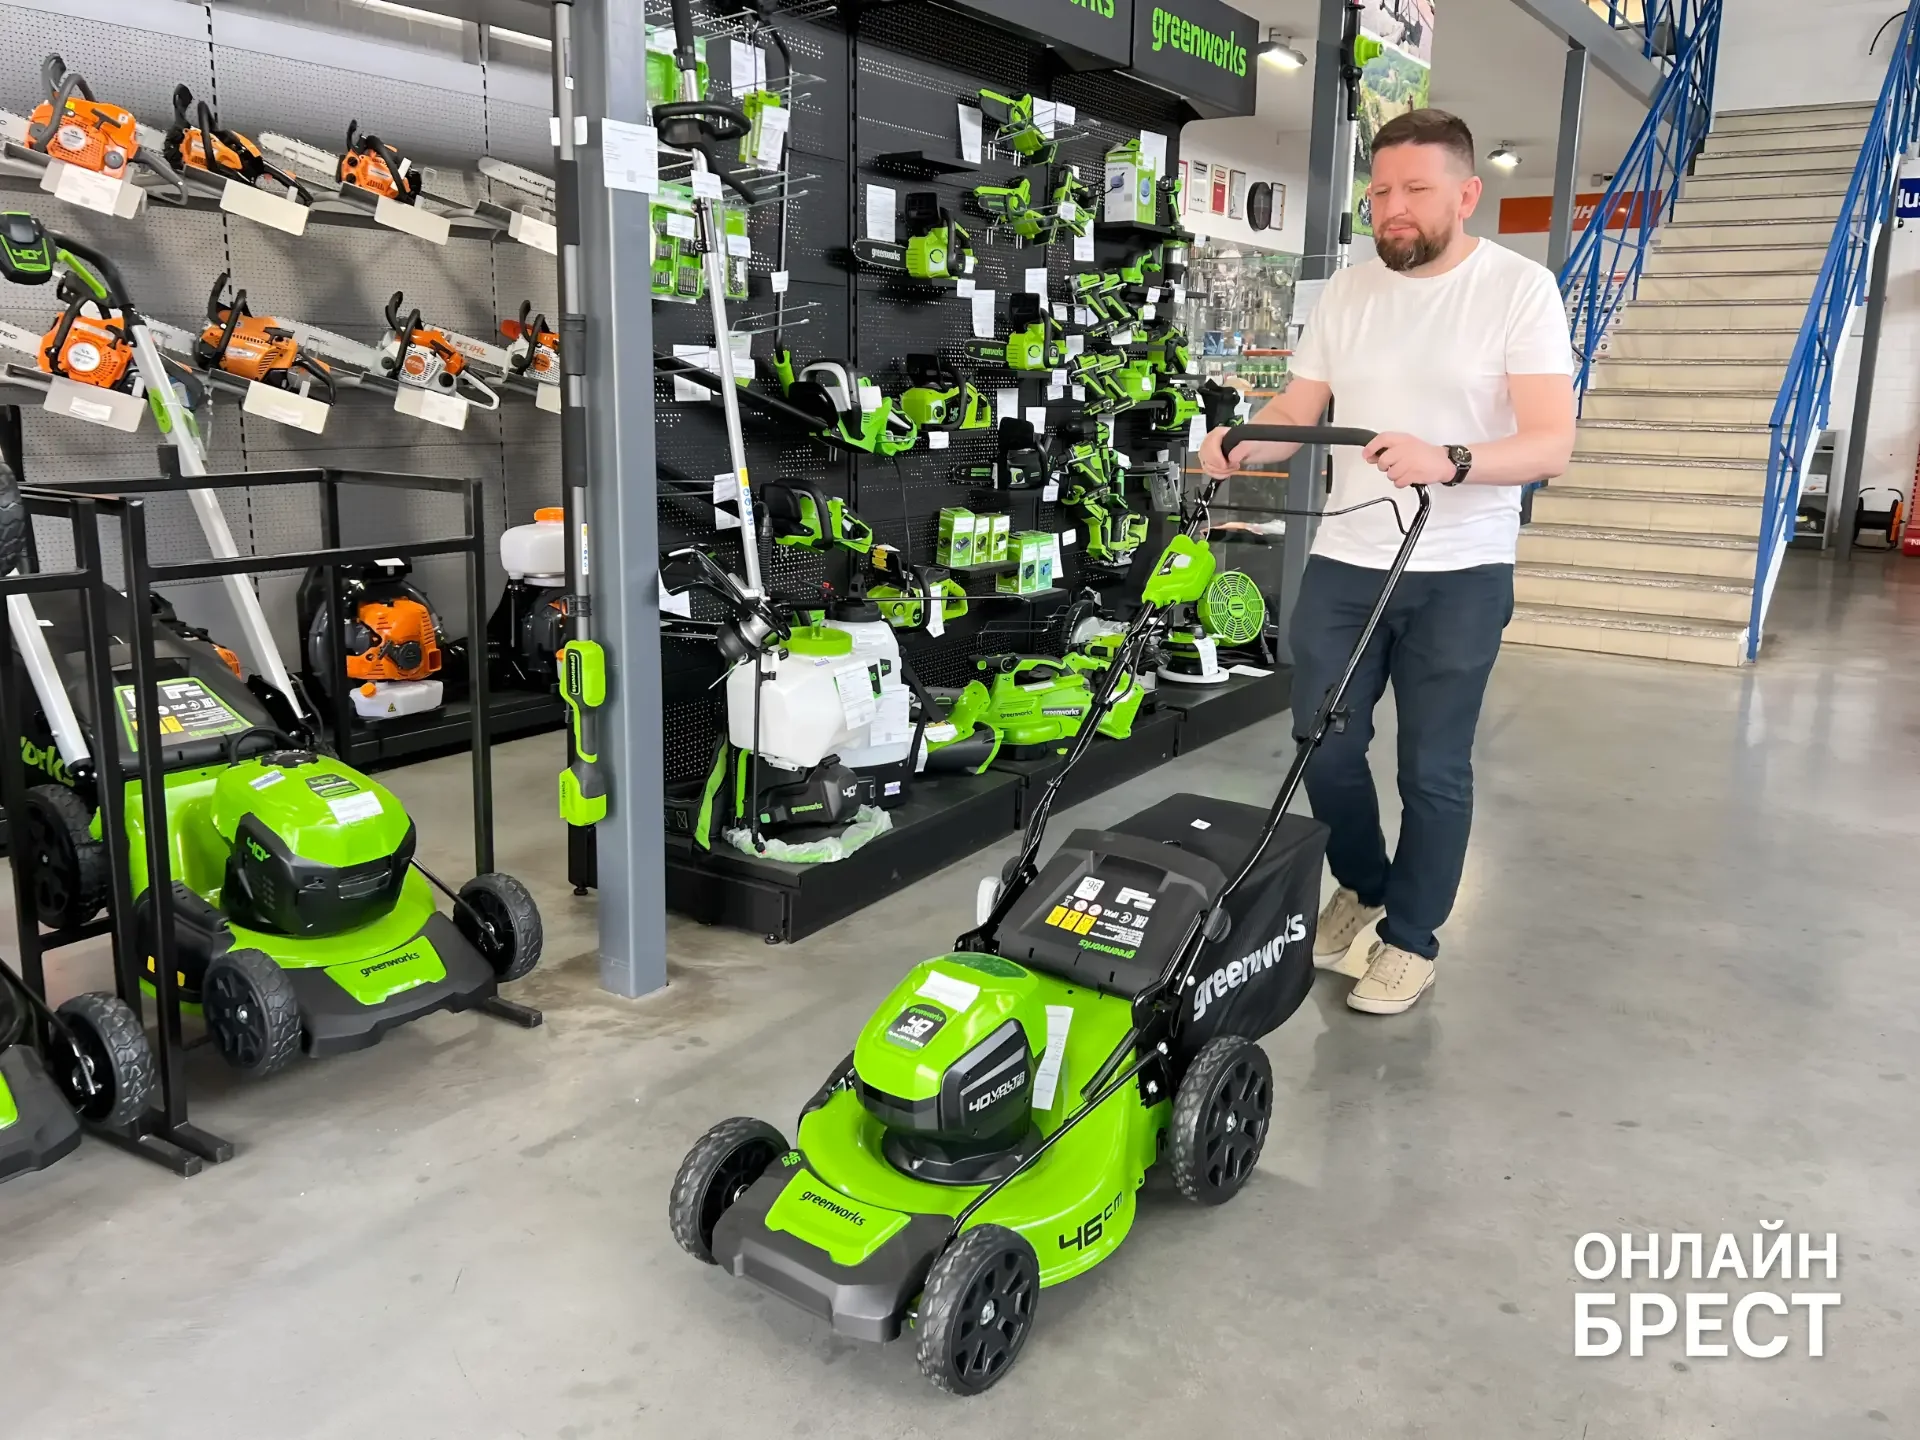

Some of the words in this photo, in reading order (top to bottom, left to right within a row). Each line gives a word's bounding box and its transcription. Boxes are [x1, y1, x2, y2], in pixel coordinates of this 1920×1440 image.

[1152, 7, 1248, 77] greenworks
[455, 341, 488, 357] STIHL
[1000, 708, 1033, 719] greenworks
[1042, 706, 1081, 717] greenworks
[1078, 939, 1137, 959] greenworks
[360, 951, 420, 978] greenworks
[968, 1092, 991, 1112] 40
[798, 1190, 867, 1227] greenworks
